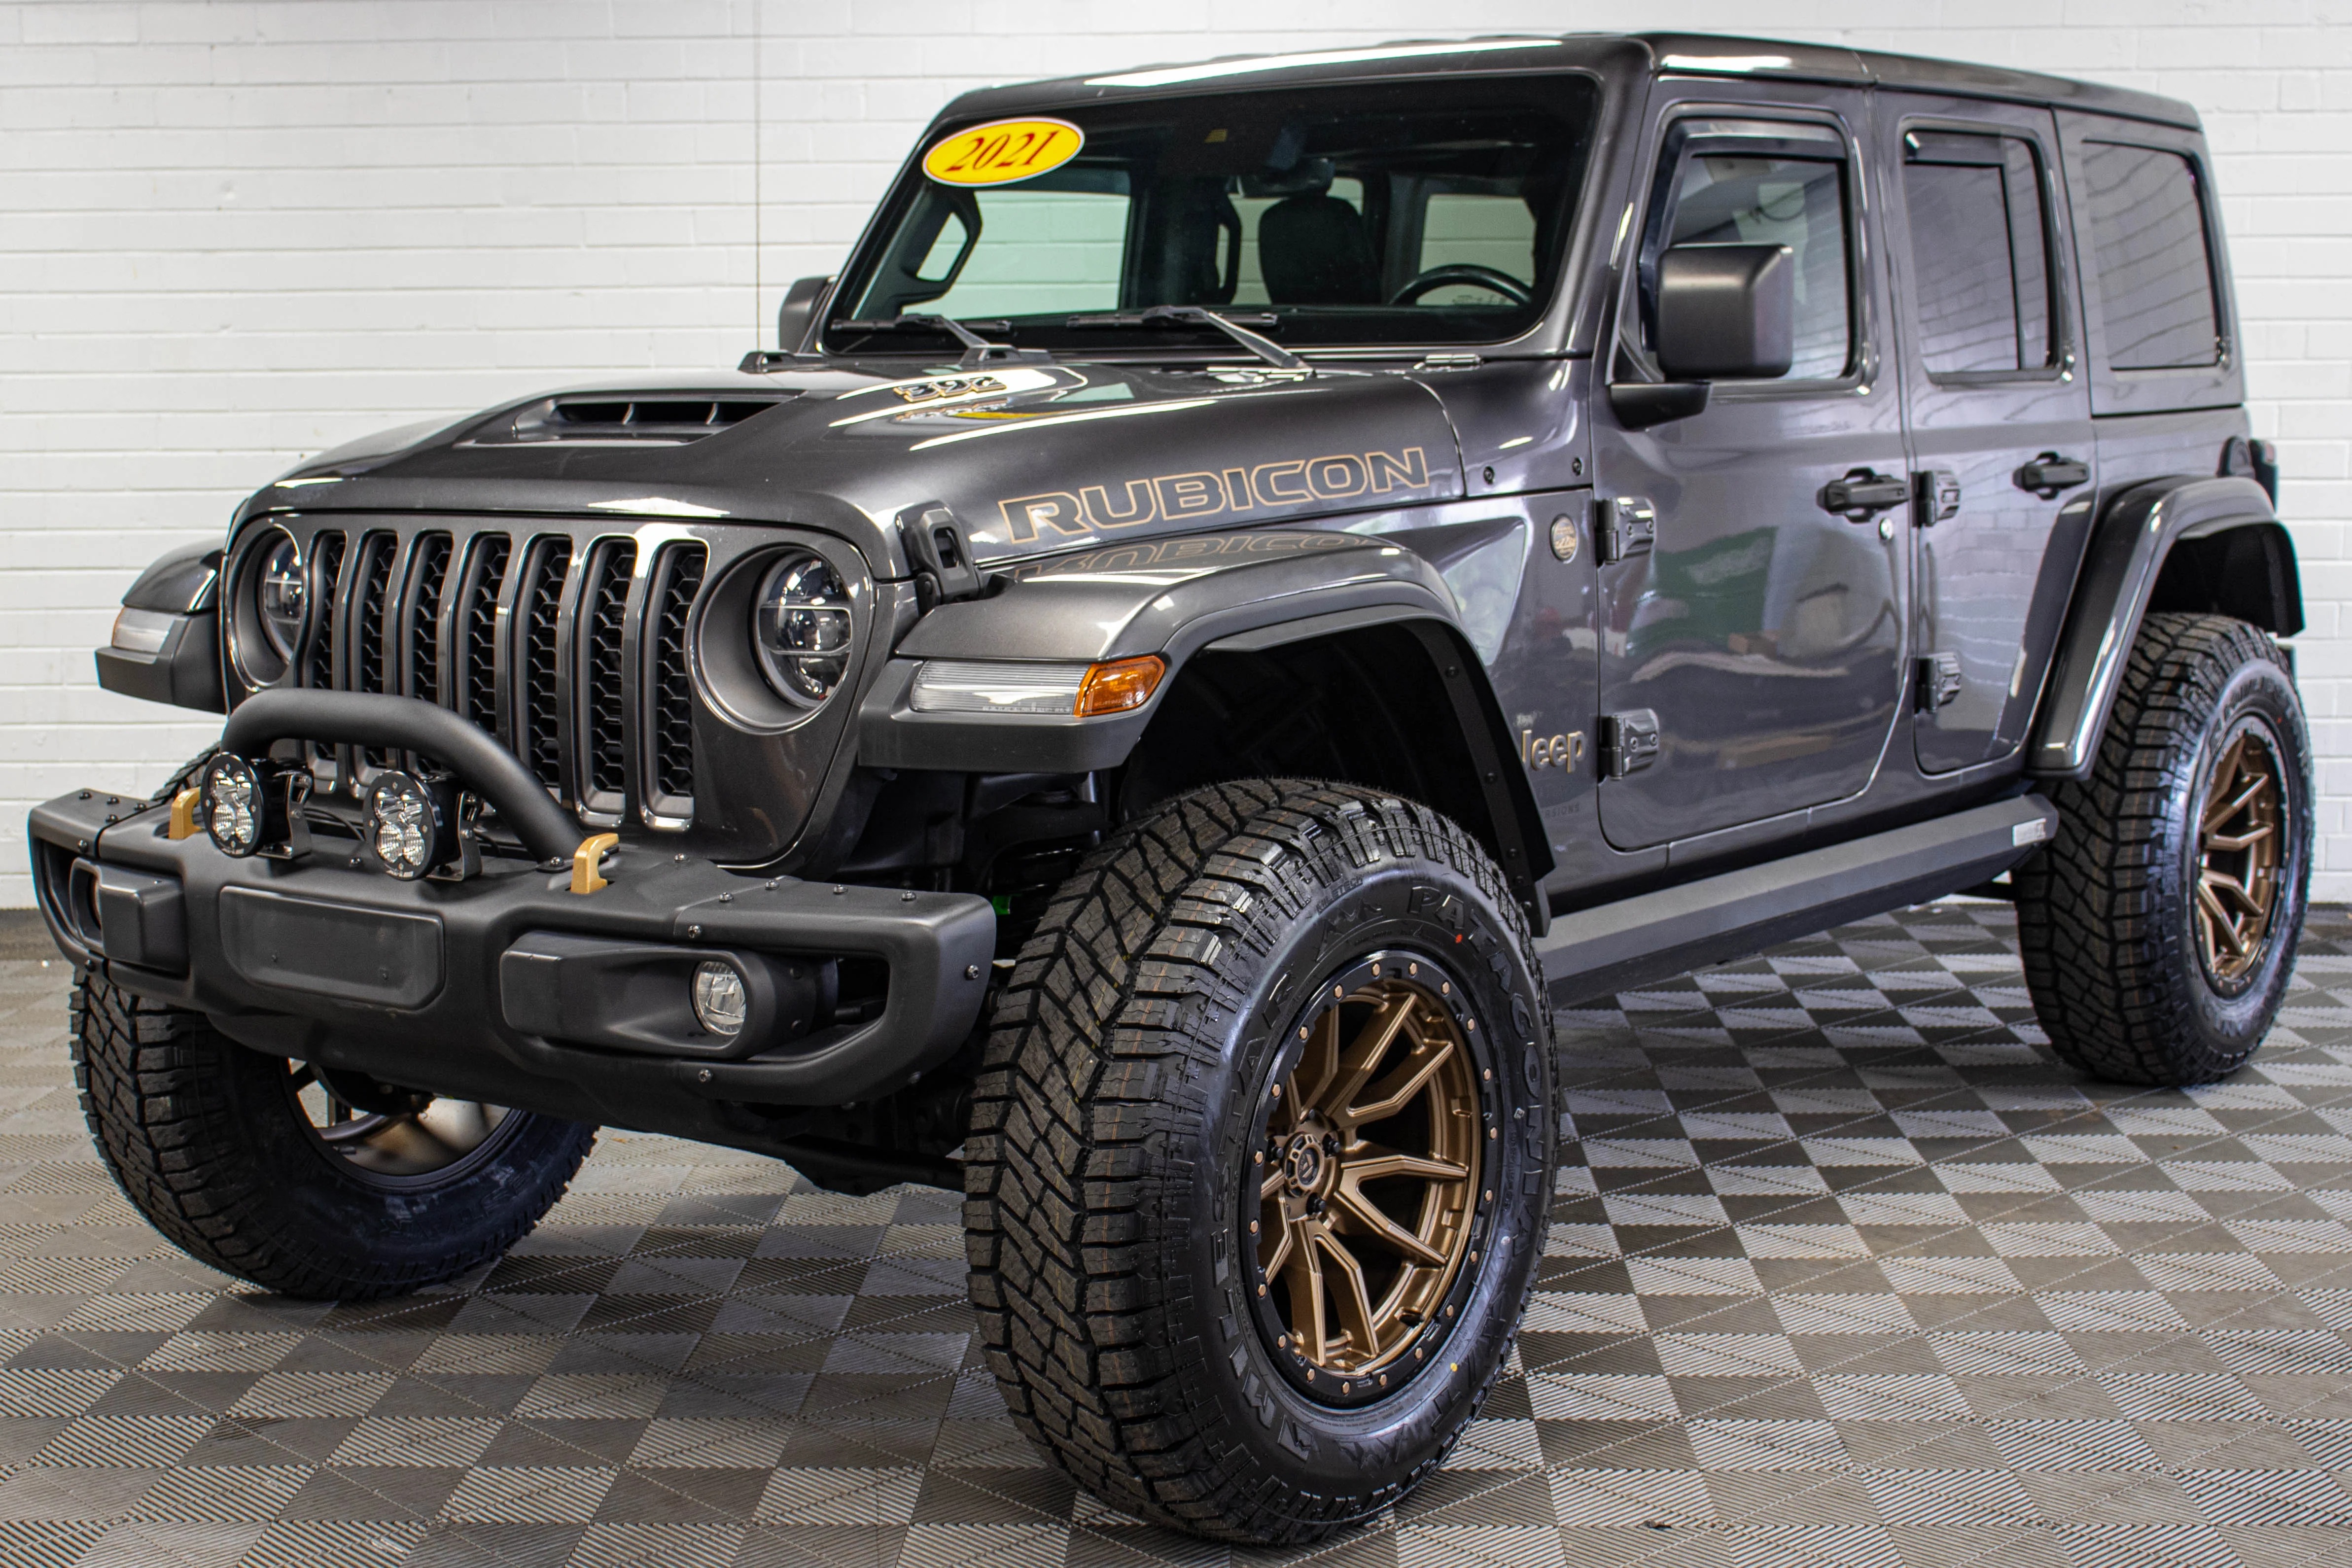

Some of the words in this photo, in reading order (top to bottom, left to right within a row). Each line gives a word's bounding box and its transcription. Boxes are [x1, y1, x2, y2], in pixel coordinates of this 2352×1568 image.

[945, 130, 1060, 173] 2021
[893, 376, 1007, 403] 392
[998, 447, 1430, 544] RUBICON
[1522, 730, 1585, 773] Jeep
[1407, 886, 1544, 1258] PATAGONIA
